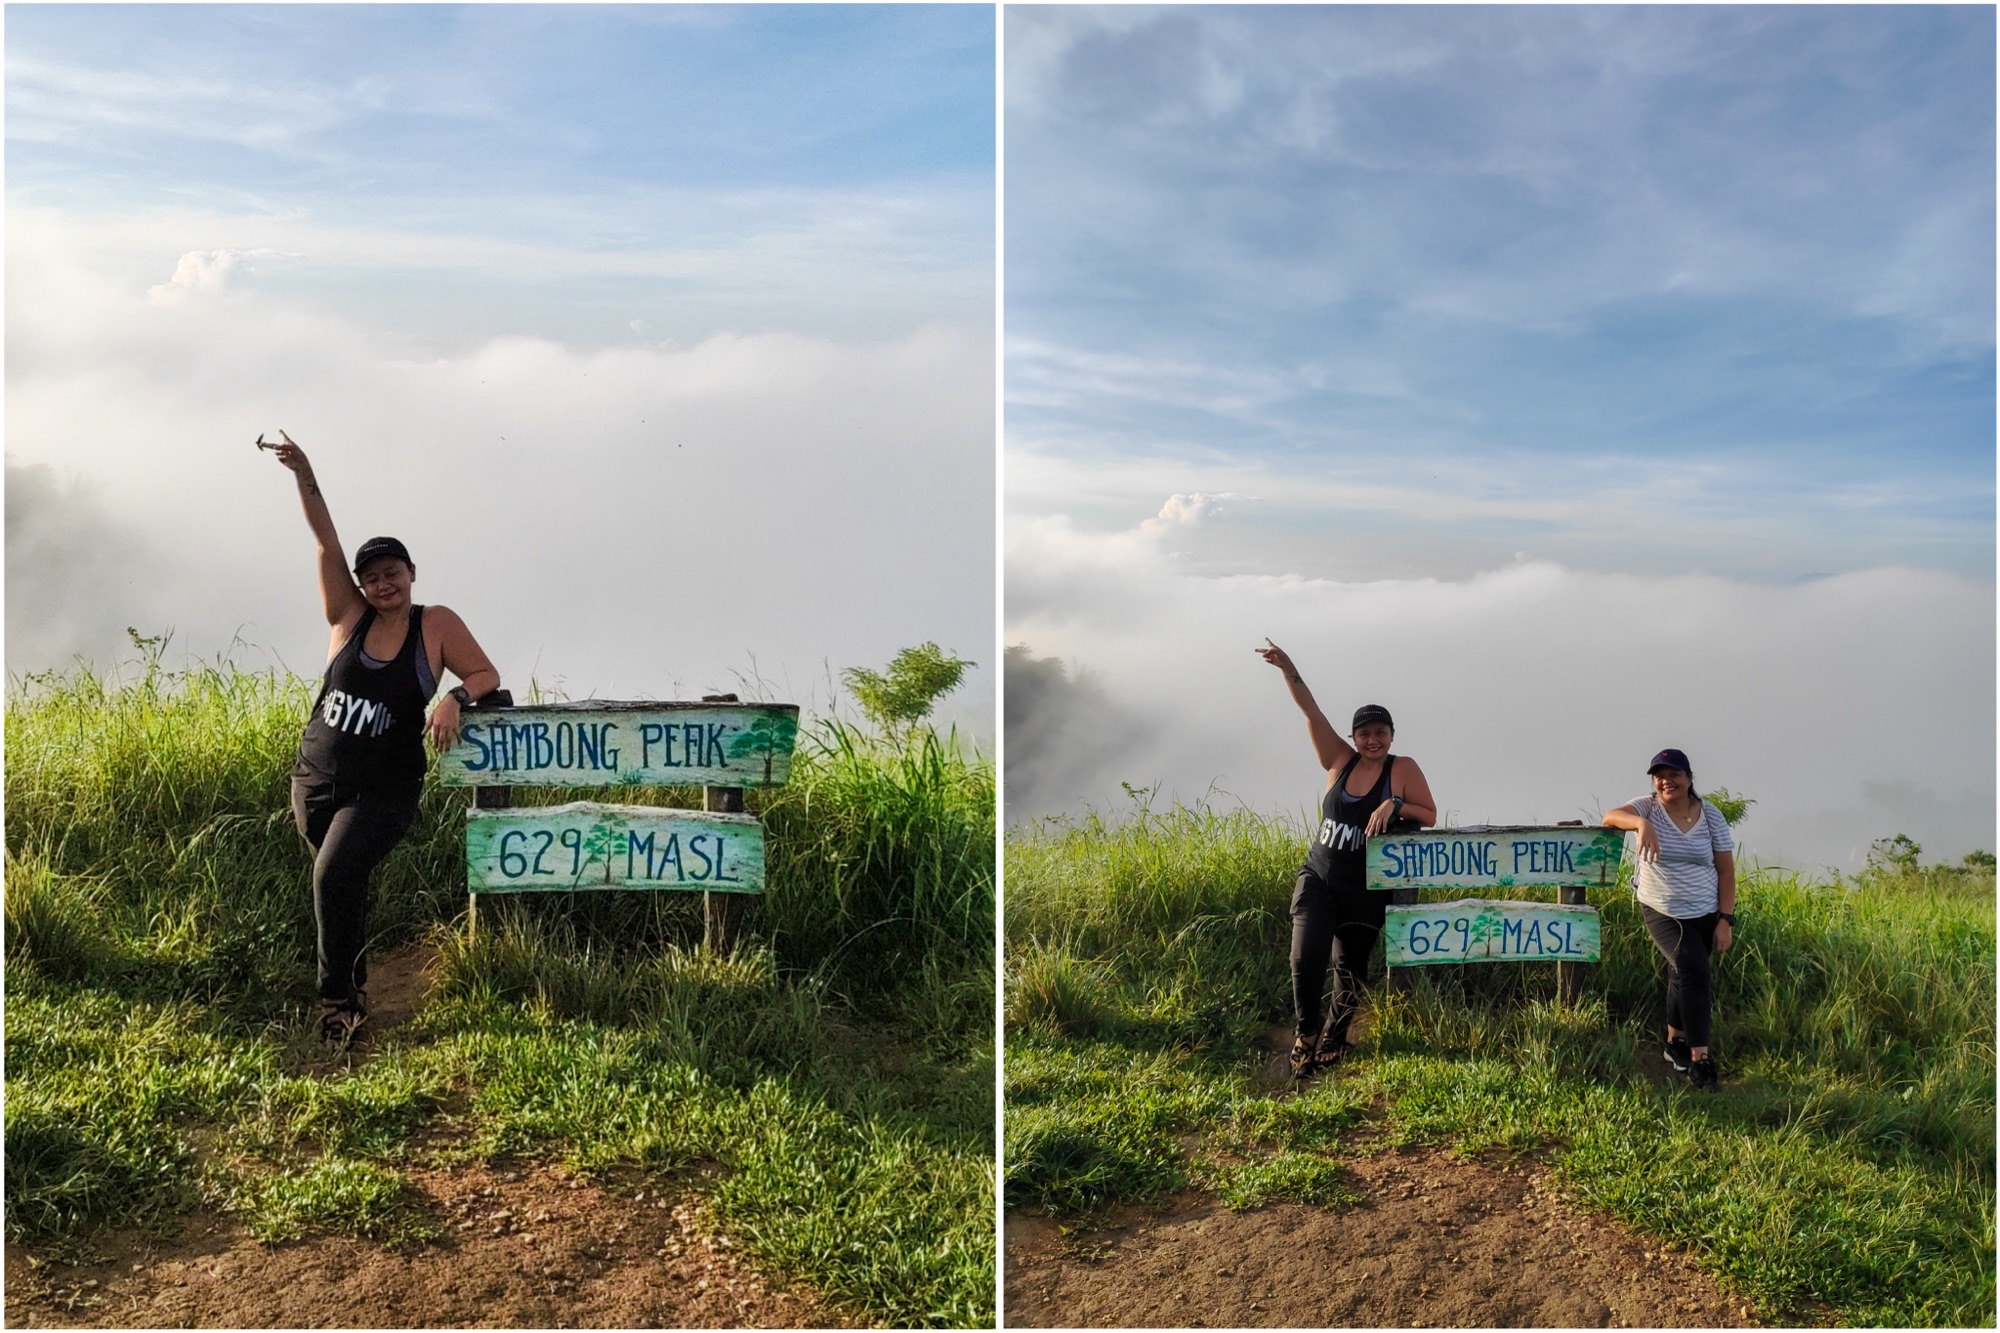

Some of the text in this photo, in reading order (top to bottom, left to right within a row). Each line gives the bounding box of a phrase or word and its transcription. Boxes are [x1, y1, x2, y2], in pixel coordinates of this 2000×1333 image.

[461, 721, 729, 774] SAMBONG PEAK
[499, 828, 741, 882] 629 MASL
[1381, 840, 1577, 878] SAMBONG PEAK
[1409, 917, 1582, 955] 629 MASL
